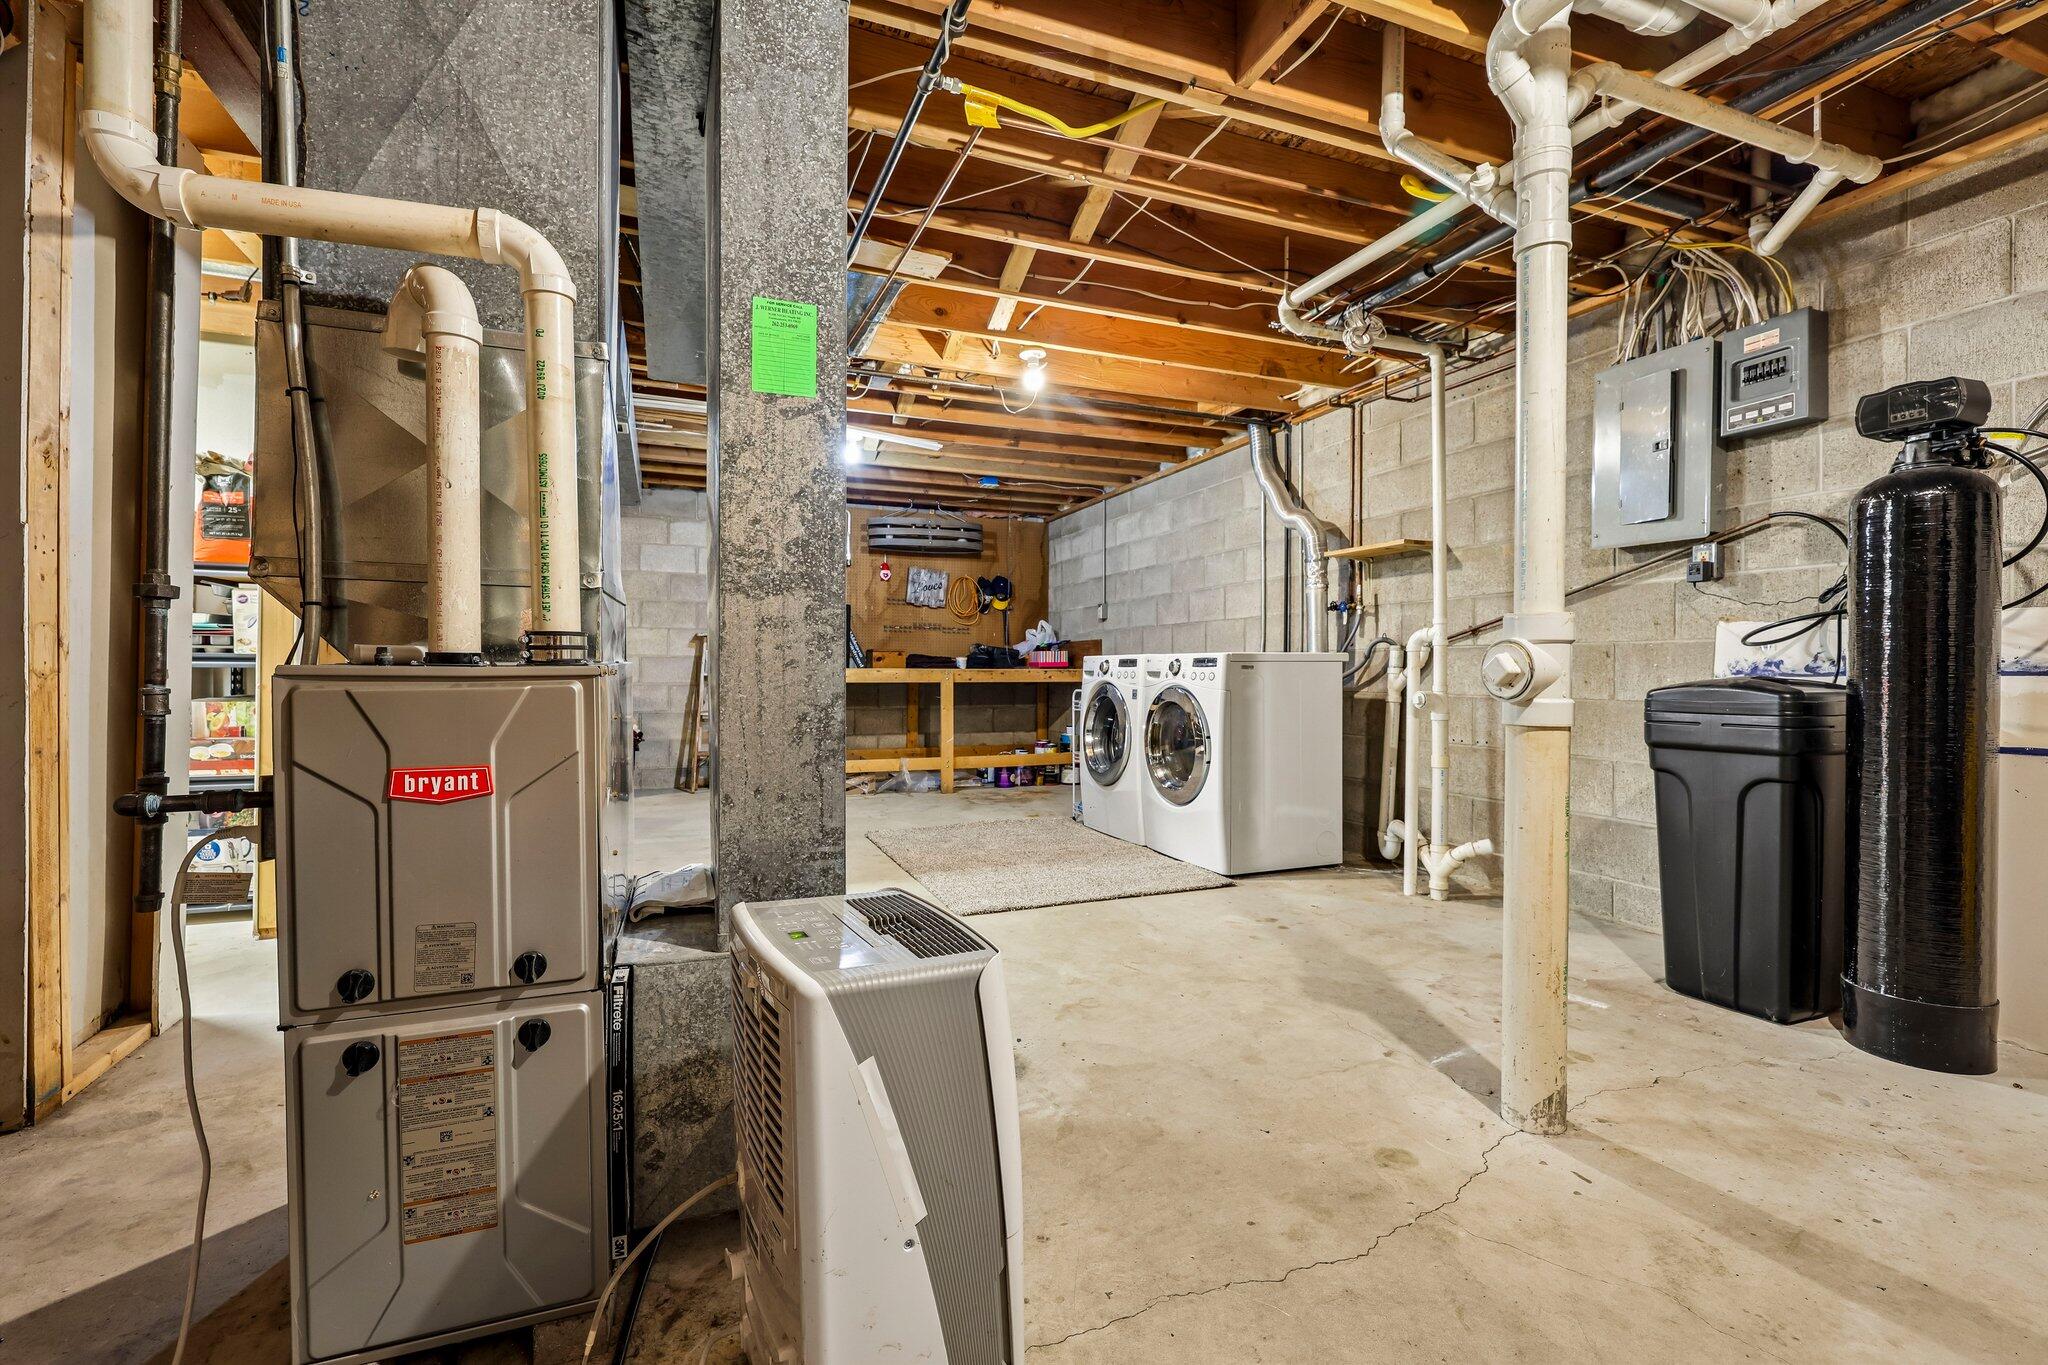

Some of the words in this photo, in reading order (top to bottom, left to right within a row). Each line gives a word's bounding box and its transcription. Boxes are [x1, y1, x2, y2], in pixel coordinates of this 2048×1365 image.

[261, 197, 280, 206] MADE
[281, 199, 288, 207] IN
[759, 304, 781, 312] WERNER
[540, 539, 550, 551] PVC
[540, 575, 550, 600] STREAM
[541, 601, 551, 613] JET
[404, 772, 479, 795] bryant
[613, 985, 624, 1031] Filtrete
[615, 1239, 625, 1258] 3M
